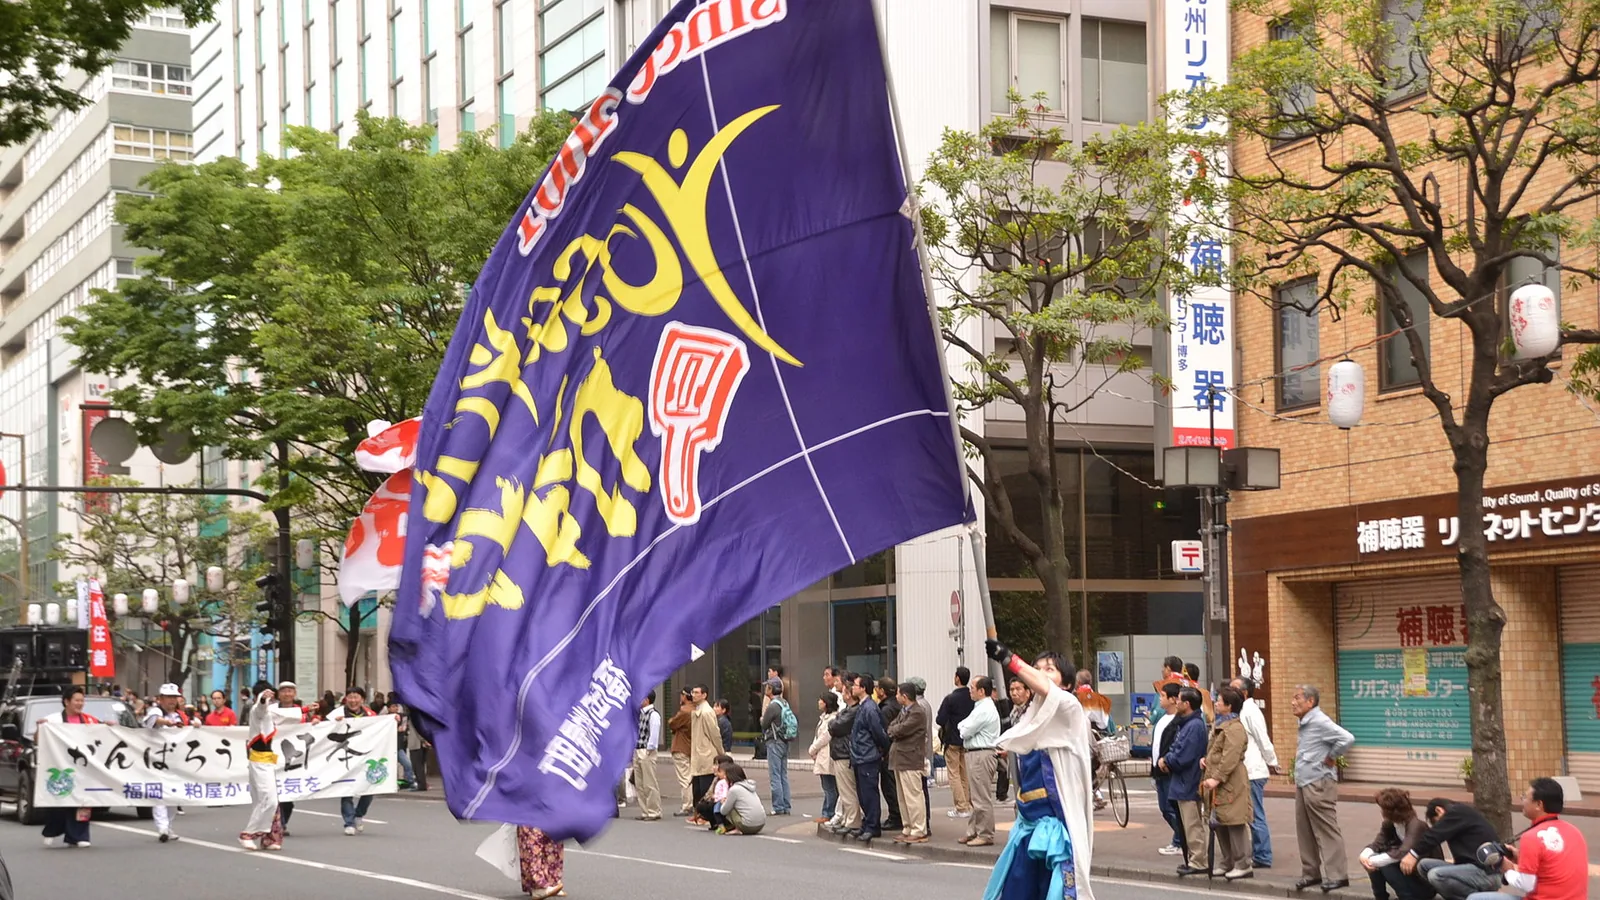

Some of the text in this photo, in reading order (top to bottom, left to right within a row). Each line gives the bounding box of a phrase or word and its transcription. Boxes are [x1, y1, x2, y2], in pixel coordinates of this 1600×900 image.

[1190, 237, 1226, 413] 補聴器
[1482, 496, 1496, 508] lity
[1498, 494, 1509, 506] of
[1545, 487, 1578, 501] Quality
[1580, 484, 1591, 497] of
[1357, 503, 1600, 552] 補聴器 リネットセンタ
[67, 723, 372, 772] がんばろう 日本
